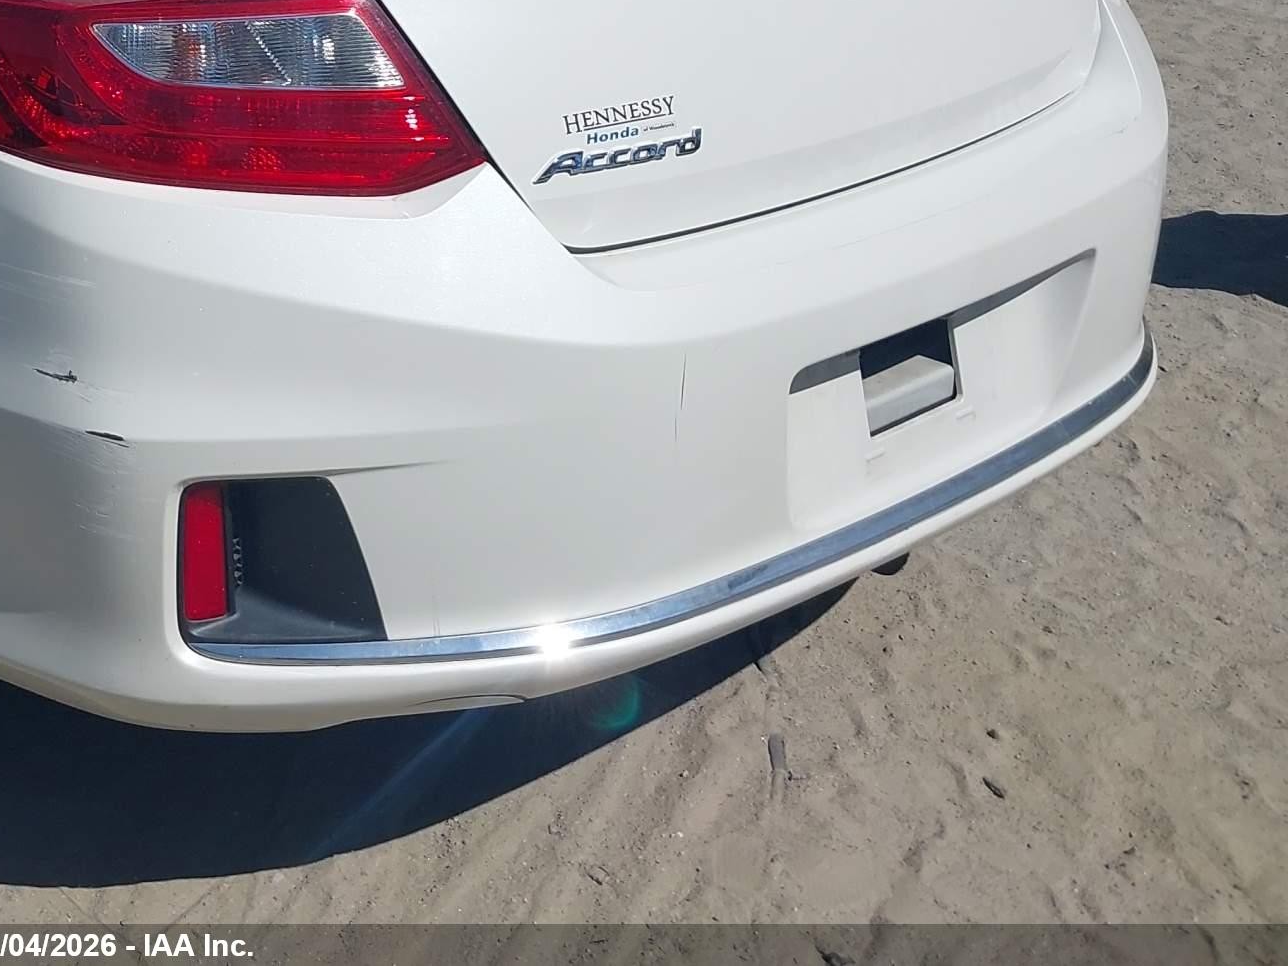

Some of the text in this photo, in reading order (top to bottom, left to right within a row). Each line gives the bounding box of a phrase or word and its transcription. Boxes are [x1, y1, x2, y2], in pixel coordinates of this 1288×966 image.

[562, 95, 675, 135] HENNESSY
[586, 126, 640, 145] Honda
[532, 128, 703, 185] Accord
